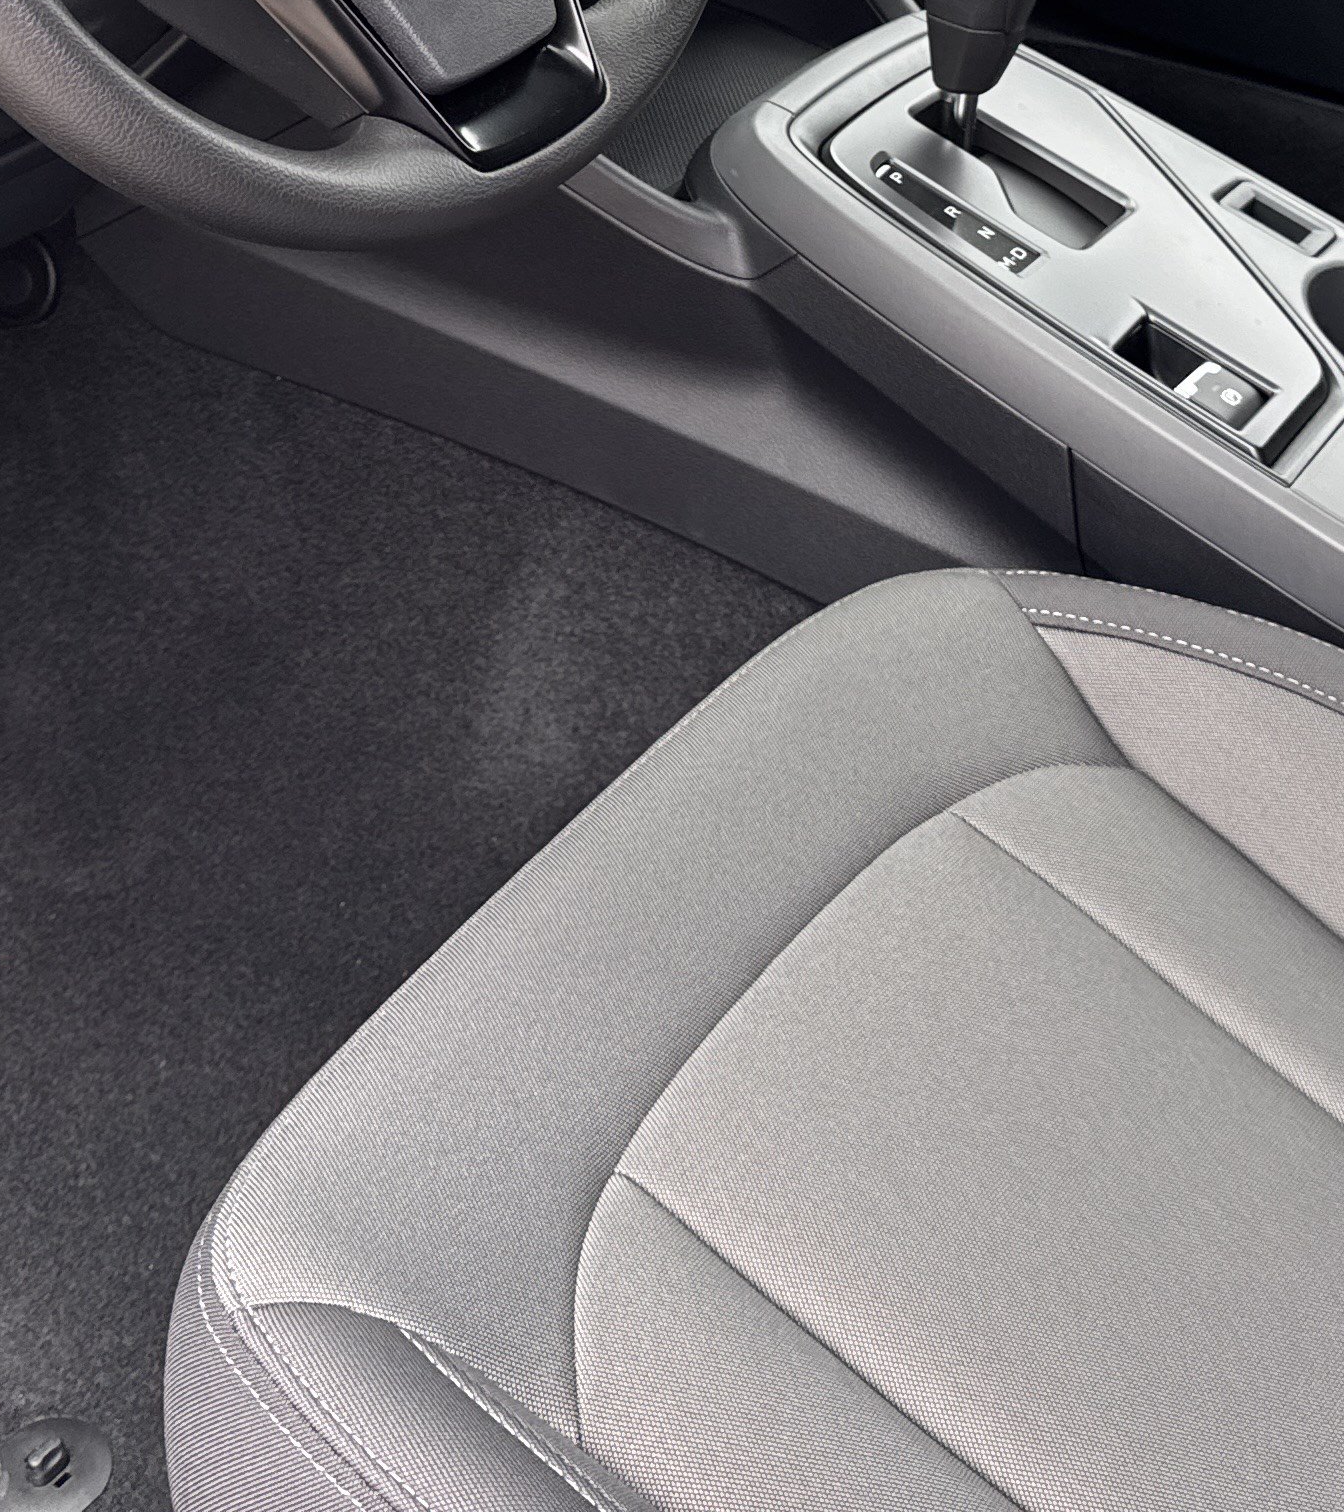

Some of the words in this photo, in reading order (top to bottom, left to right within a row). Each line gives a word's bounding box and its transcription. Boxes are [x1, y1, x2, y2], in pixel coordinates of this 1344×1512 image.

[889, 171, 903, 185] P
[943, 205, 962, 219] R
[976, 225, 996, 240] N
